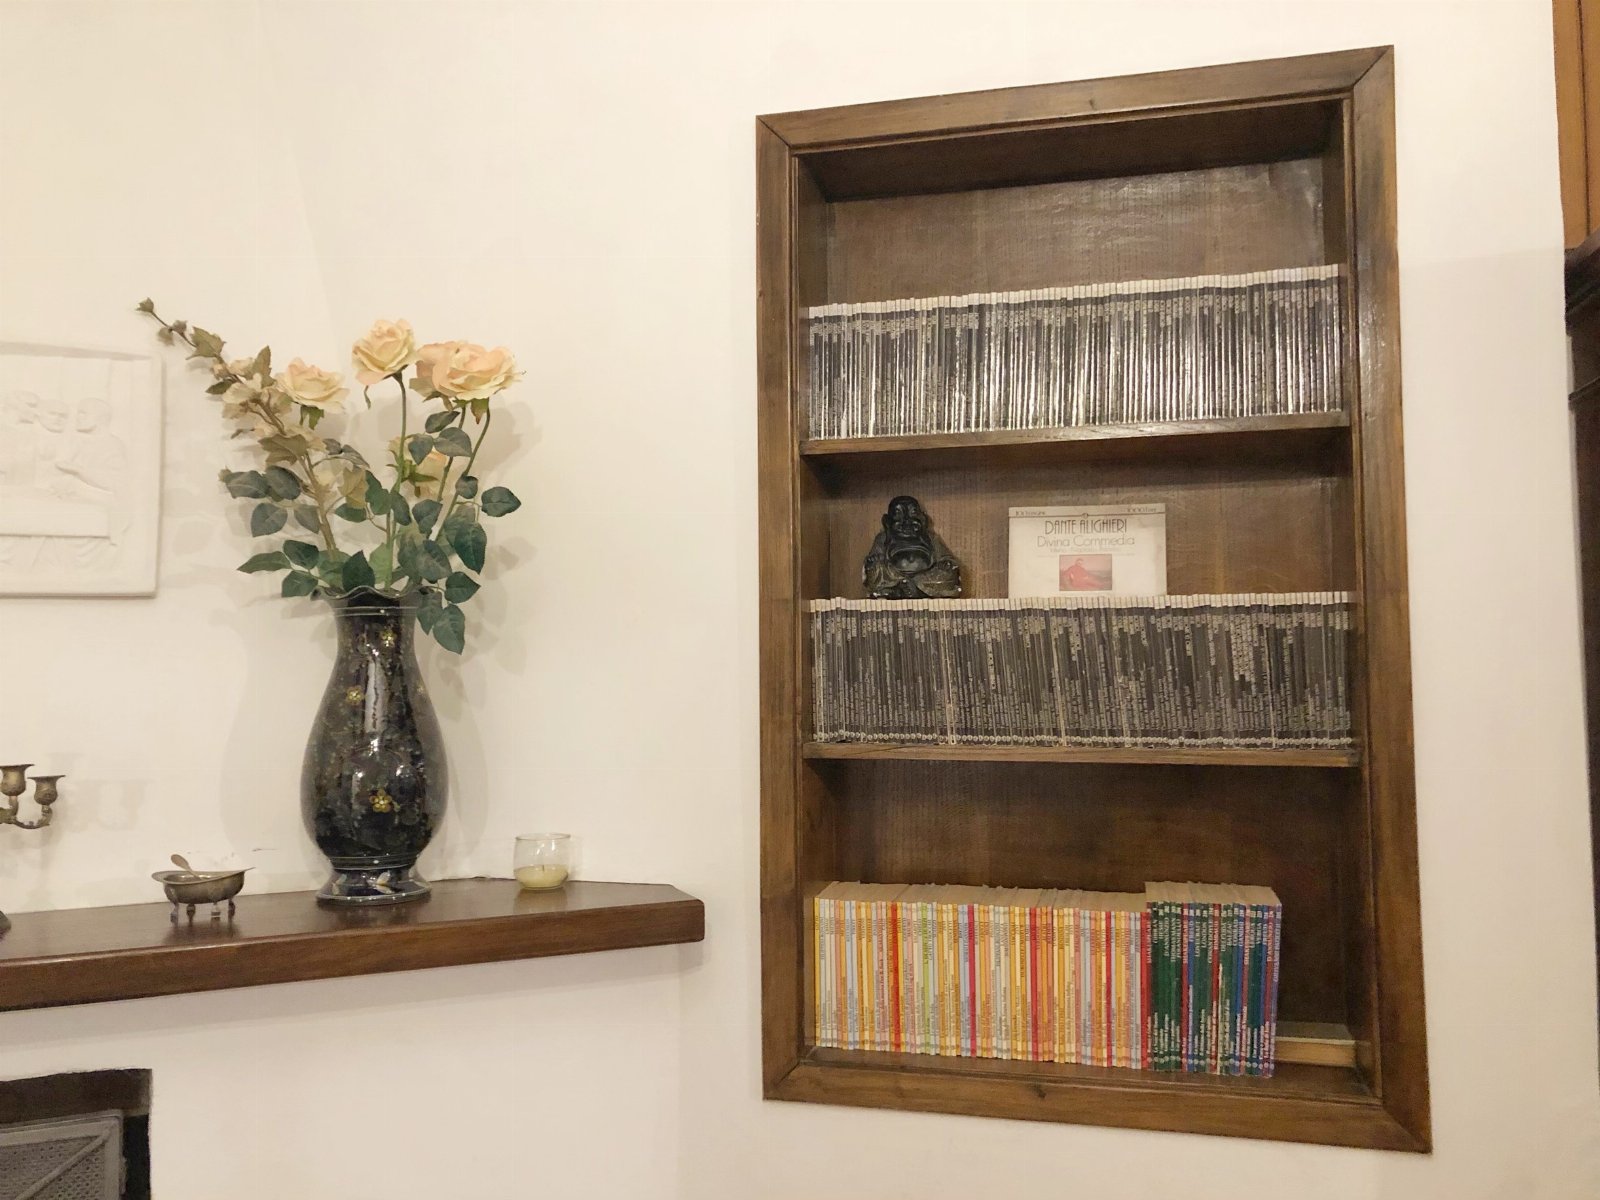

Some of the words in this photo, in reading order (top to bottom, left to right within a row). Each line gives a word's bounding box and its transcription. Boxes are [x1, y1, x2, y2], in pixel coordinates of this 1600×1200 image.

[1044, 520, 1077, 535] DANTE
[1079, 518, 1128, 534] ALIGHIERI
[1037, 536, 1071, 548] Divina
[1073, 534, 1135, 548] Commedia
